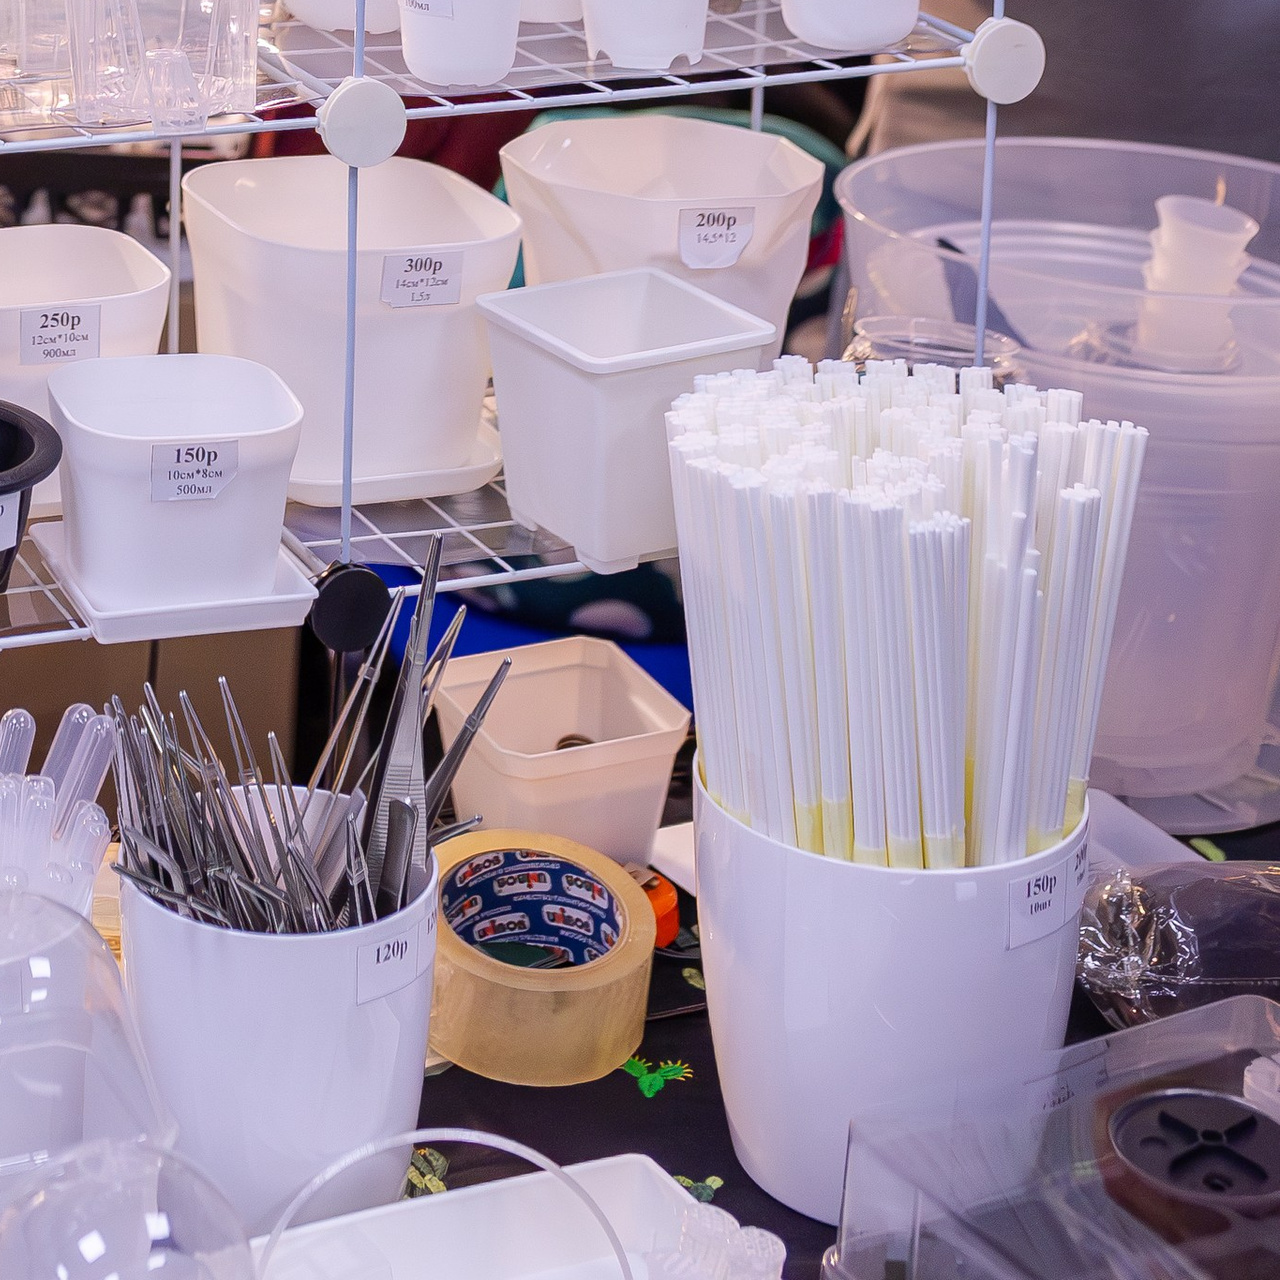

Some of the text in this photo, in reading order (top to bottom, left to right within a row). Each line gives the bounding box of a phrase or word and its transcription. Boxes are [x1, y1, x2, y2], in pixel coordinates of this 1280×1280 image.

[695, 212, 737, 231] 200р
[403, 257, 443, 275] 300р
[39, 311, 81, 330] 250р
[42, 348, 76, 359] 900мл
[175, 446, 218, 466] 150р
[176, 484, 212, 496] 500мл
[1026, 875, 1057, 898] 150р
[376, 939, 408, 964] 120р
